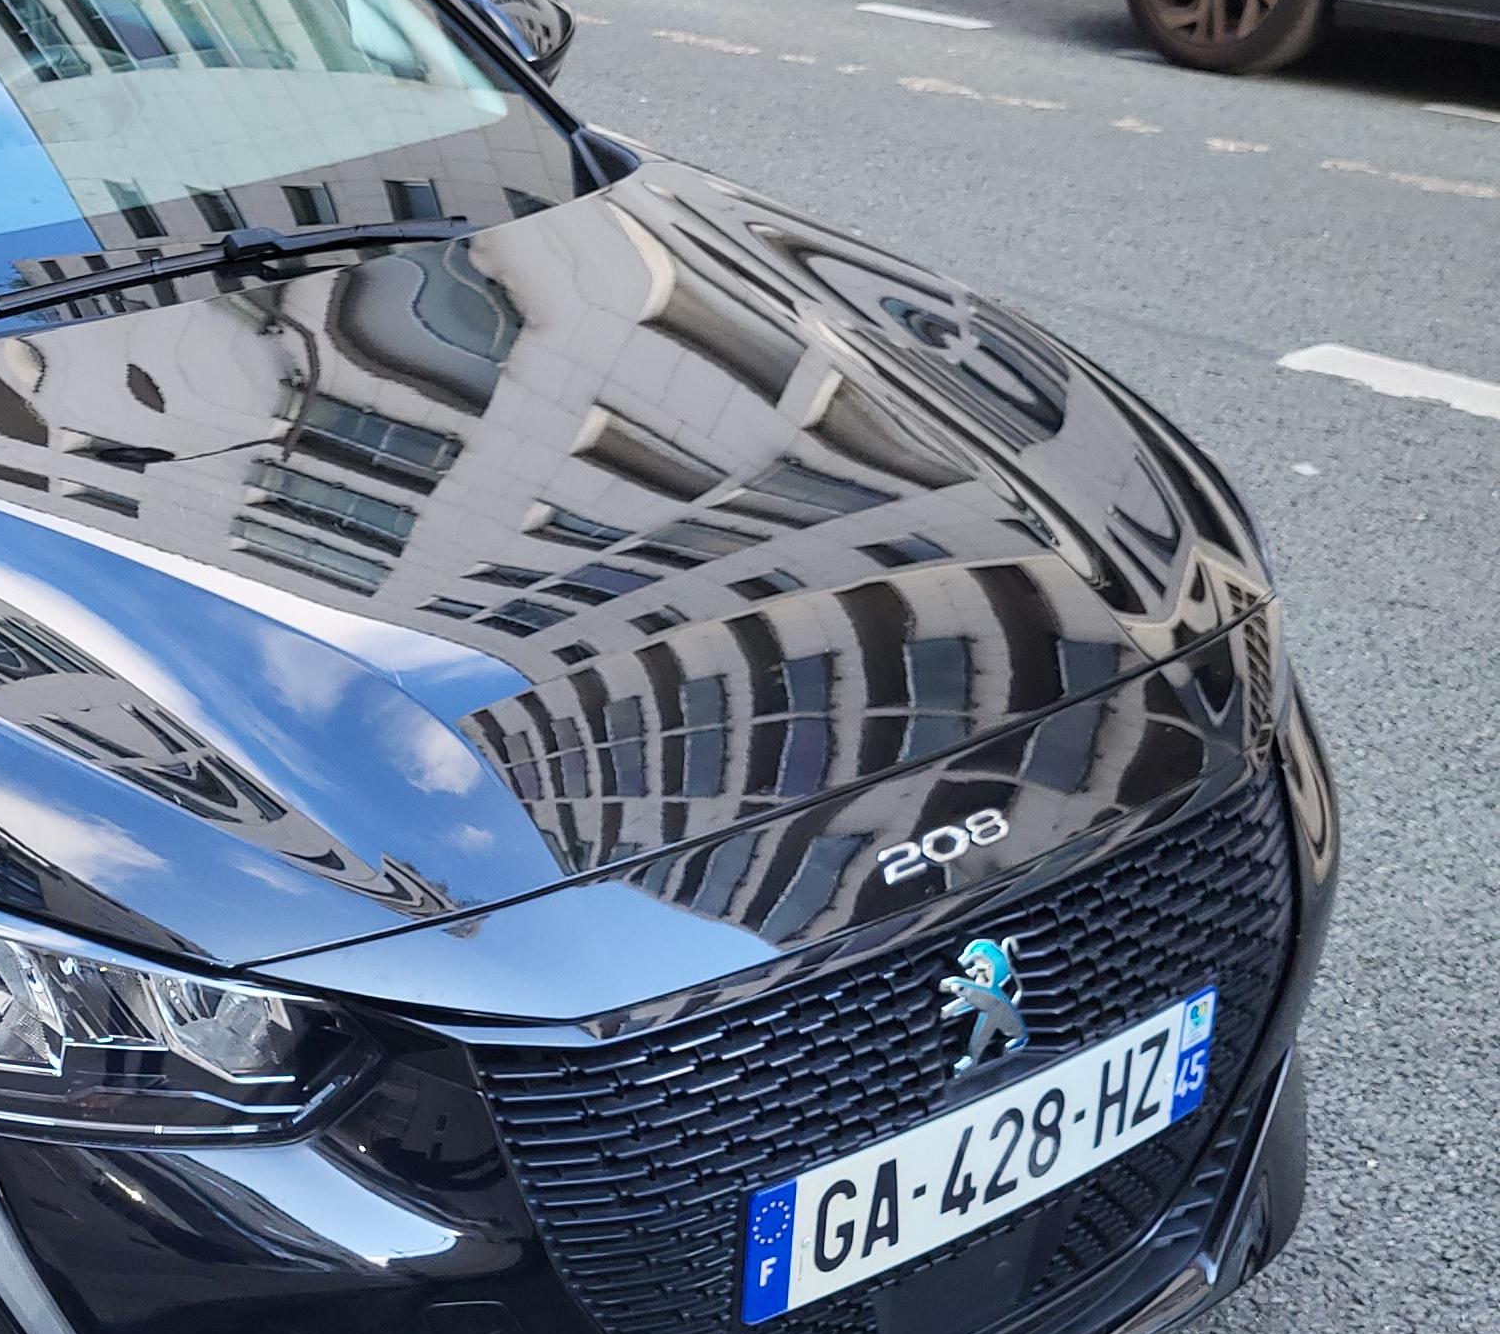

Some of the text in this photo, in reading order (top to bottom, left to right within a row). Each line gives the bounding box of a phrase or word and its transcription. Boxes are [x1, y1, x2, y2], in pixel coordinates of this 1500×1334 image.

[877, 808, 1009, 884] 208
[1174, 1049, 1206, 1098] 45
[813, 1027, 1171, 1273] GA-428-HZ
[760, 1257, 777, 1286] F
